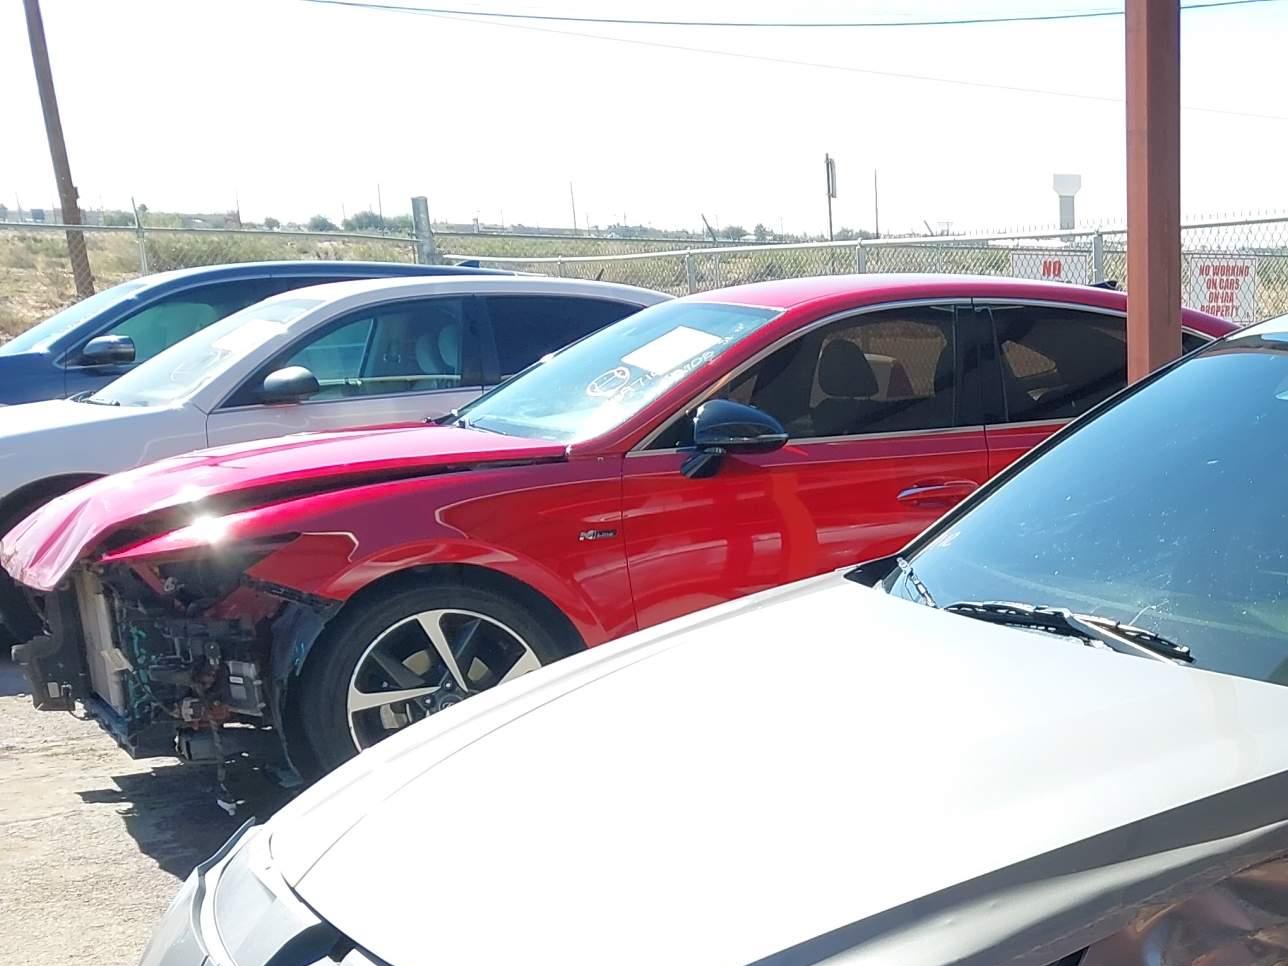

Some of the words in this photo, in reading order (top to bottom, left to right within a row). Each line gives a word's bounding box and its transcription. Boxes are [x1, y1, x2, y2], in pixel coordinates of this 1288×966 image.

[1042, 260, 1062, 278] NO
[1199, 264, 1211, 277] NO
[1206, 278, 1217, 290] ON
[1219, 278, 1240, 290] CARS
[1208, 291, 1219, 303] ON
